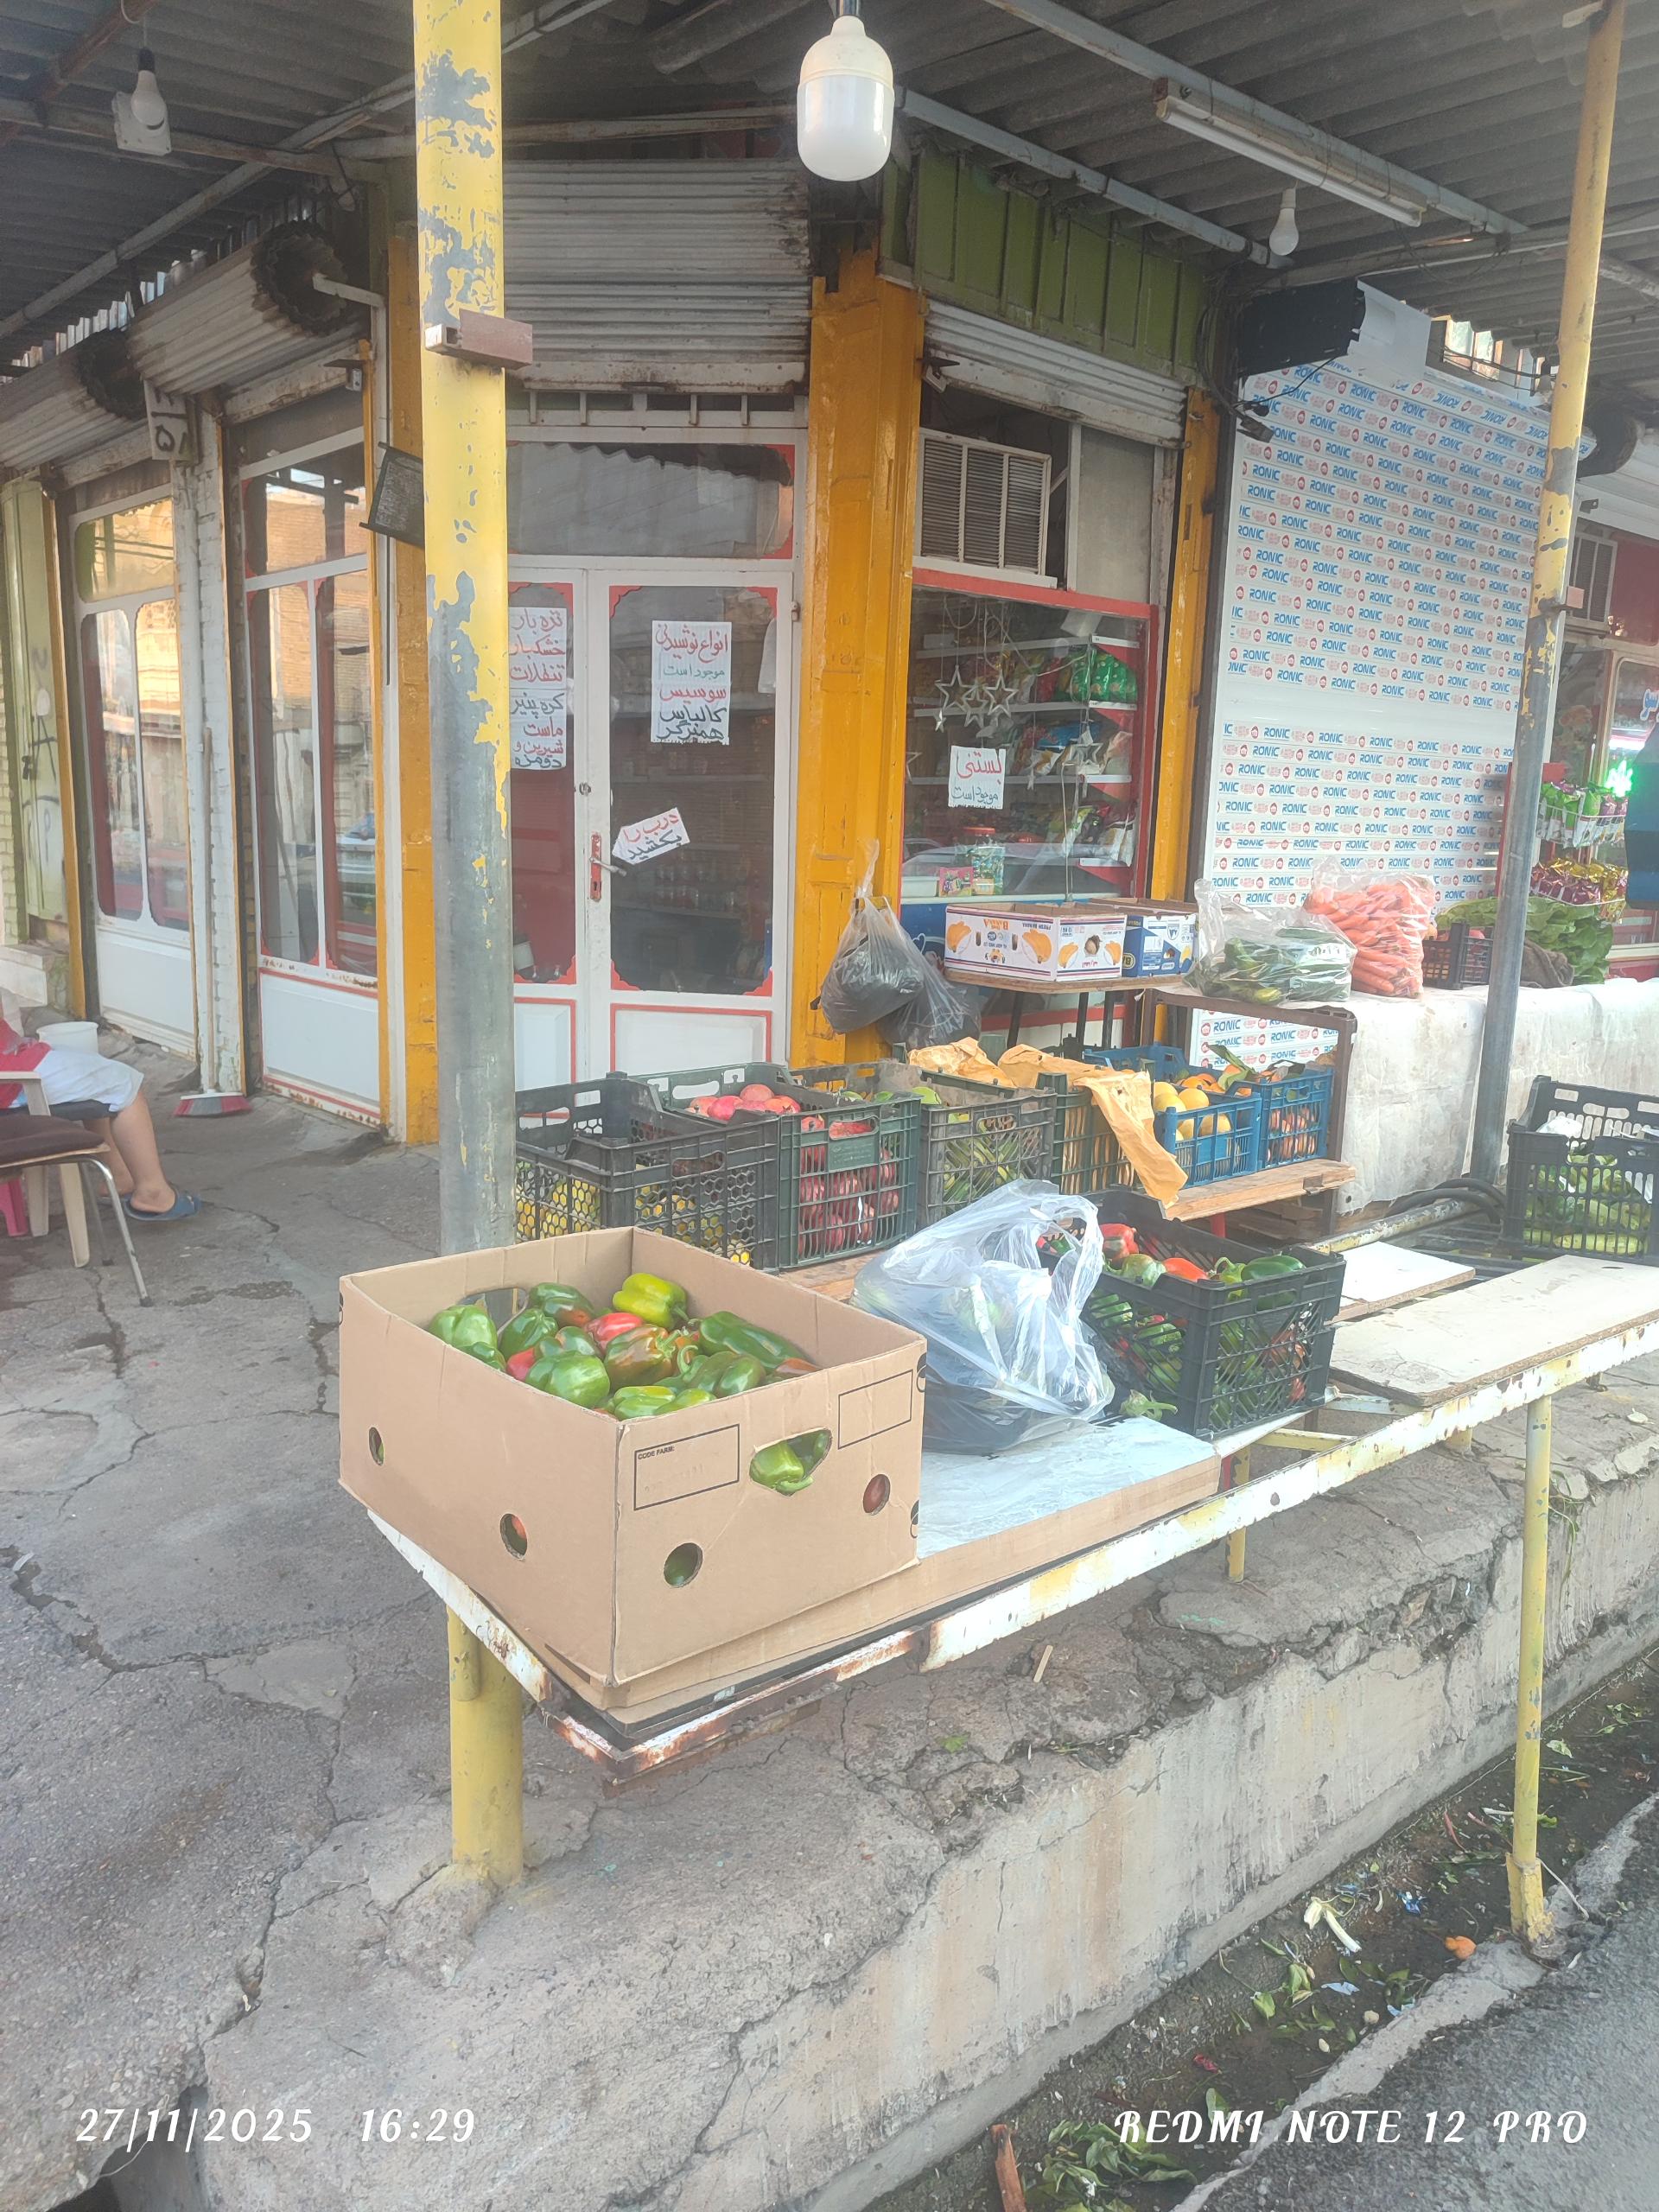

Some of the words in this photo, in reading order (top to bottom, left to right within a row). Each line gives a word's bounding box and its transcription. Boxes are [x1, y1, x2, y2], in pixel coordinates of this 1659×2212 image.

[1350, 383, 1377, 402] RONIC
[1402, 401, 1427, 418] RONIC
[1450, 418, 1474, 434] RONIC
[1338, 403, 1365, 420] RONIC
[1390, 420, 1416, 435] RONIC
[1439, 436, 1463, 451] RONIC
[1484, 451, 1507, 465] RONIC
[1310, 415, 1337, 432] RONIC
[1363, 432, 1389, 448] RONIC
[1413, 448, 1436, 463] RONIC
[1459, 463, 1481, 478] RONIC
[1326, 442, 1351, 459] RONIC
[1378, 458, 1402, 474] RONIC
[1427, 473, 1449, 486] RONIC
[1472, 486, 1493, 499] RONIC
[1252, 464, 1281, 481] RONIC
[1310, 480, 1336, 495] RONIC
[1363, 494, 1387, 509] RONIC
[1413, 507, 1435, 521] RONIC
[1277, 449, 1304, 466] RONIC
[1332, 466, 1358, 481] RONIC
[1384, 480, 1408, 494] RONIC
[1433, 493, 1454, 508] RONIC
[1478, 506, 1498, 519] RONIC
[1248, 485, 1275, 500] RONIC
[1306, 499, 1332, 514] RONIC
[1358, 513, 1382, 527] RONIC
[1409, 525, 1431, 538] RONIC
[1455, 537, 1476, 550] RONIC
[1281, 515, 1308, 530] RONIC
[1337, 527, 1361, 542] RONIC
[1389, 539, 1411, 553] RONIC
[1435, 550, 1457, 563] RONIC
[1294, 537, 1320, 552] RONIC
[1349, 550, 1373, 563] RONIC
[1399, 561, 1421, 574] RONIC
[1256, 550, 1284, 564] RONIC
[1313, 562, 1338, 575] RONIC
[1364, 572, 1389, 585] RONIC
[1414, 583, 1436, 595] RONIC
[1262, 568, 1289, 583] RONIC
[1318, 581, 1342, 594] RONIC
[1370, 592, 1393, 605] RONIC
[1418, 601, 1440, 613] RONIC
[1249, 588, 1277, 602] RONIC
[1306, 599, 1332, 612] RONIC
[1358, 608, 1382, 620] RONIC
[1408, 617, 1430, 629] RONIC
[1453, 626, 1474, 637] RONIC
[1274, 613, 1300, 626] RONIC
[1329, 622, 1353, 634] RONIC
[1380, 630, 1402, 642] RONIC
[1427, 638, 1449, 650] RONIC
[1471, 645, 1492, 657] RONIC
[698, 630, 728, 664] انواع
[1266, 631, 1294, 644] RONIC
[1322, 639, 1347, 652] RONIC
[1373, 647, 1396, 659] RONIC
[1421, 654, 1443, 666] RONIC
[1465, 661, 1486, 672] RONIC
[663, 664, 693, 676] است
[694, 669, 726, 680] موجود
[1243, 649, 1269, 661] RONIC
[1300, 656, 1325, 668] RONIC
[1353, 663, 1376, 675] RONIC
[1402, 670, 1424, 681] RONIC
[1447, 676, 1469, 687] RONIC
[659, 688, 727, 704] سوسیس
[1277, 670, 1304, 683] RONIC
[1332, 677, 1355, 690] RONIC
[1382, 684, 1405, 696] RONIC
[1429, 691, 1450, 702] RONIC
[524, 716, 563, 737] ماست
[659, 704, 728, 726] کالباس
[1264, 728, 1290, 739] RONIC
[1319, 733, 1342, 743] RONIC
[1370, 737, 1393, 747] RONIC
[1417, 741, 1439, 751] RONIC
[956, 750, 1002, 785] بستنی
[1253, 746, 1280, 757] RONIC
[1308, 750, 1333, 760] RONIC
[1360, 753, 1383, 764] RONIC
[1408, 758, 1430, 767] RONIC
[1452, 761, 1473, 771] RONIC
[1238, 764, 1265, 775] RONIC
[1294, 767, 1319, 778] RONIC
[1347, 771, 1371, 780] RONIC
[1395, 774, 1418, 783] RONIC
[1441, 777, 1462, 786] RONIC
[951, 785, 976, 801] است
[975, 786, 999, 804] موجود
[1269, 785, 1295, 794] RONIC
[1323, 787, 1347, 797] RONIC
[1373, 790, 1396, 799] RONIC
[1420, 791, 1441, 801] RONIC
[1225, 801, 1252, 811] RONIC
[1282, 804, 1306, 813] RONIC
[1335, 805, 1358, 815] RONIC
[1384, 807, 1407, 817] RONIC
[1430, 810, 1451, 818] RONIC
[643, 814, 679, 836] درب
[1261, 821, 1286, 830] RONIC
[1315, 823, 1338, 832] RONIC
[1365, 823, 1388, 833] RONIC
[1412, 825, 1433, 834] RONIC
[627, 830, 683, 861] بکشید
[1294, 839, 1319, 848] RONIC
[1346, 840, 1369, 849] RONIC
[1440, 841, 1462, 849] RONIC
[1232, 858, 1259, 868] RONIC
[1389, 858, 1410, 867] RONIC
[1433, 858, 1454, 867] RONIC
[1269, 876, 1294, 886] RONIC
[1246, 893, 1271, 902] RONIC
[1213, 1020, 1241, 1032] RONIC
[1271, 1030, 1295, 1041] RONIC
[638, 1451, 656, 1460] CODE
